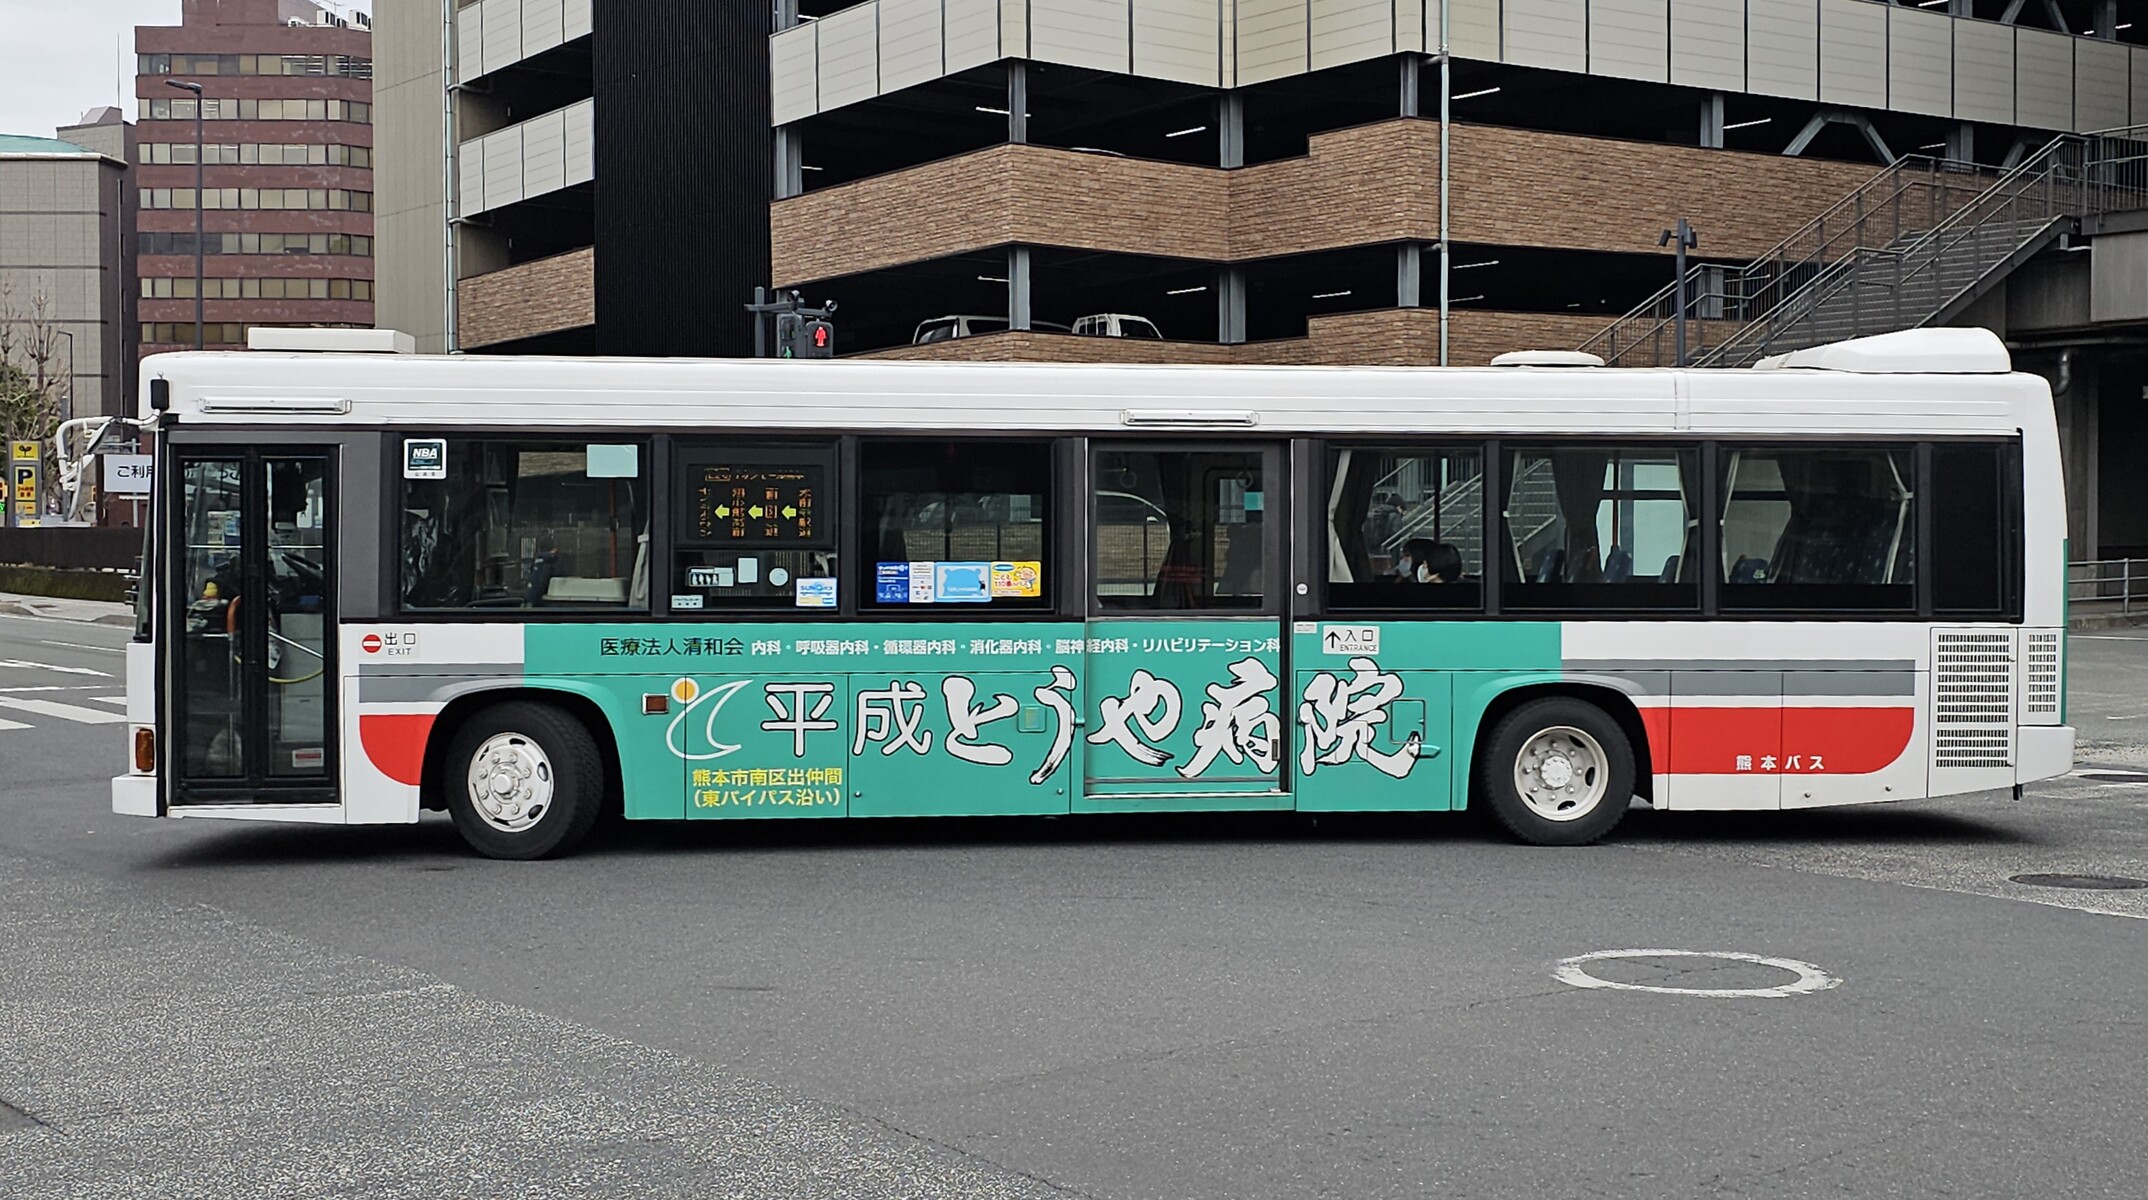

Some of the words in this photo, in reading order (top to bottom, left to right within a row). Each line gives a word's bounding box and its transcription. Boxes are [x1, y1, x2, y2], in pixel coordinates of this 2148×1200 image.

[412, 447, 438, 460] NBA
[18, 469, 33, 484] P
[385, 632, 416, 645] 出口
[1344, 629, 1374, 642] 入口
[600, 638, 744, 656] 医療法人清和会
[1340, 644, 1377, 652] ENTRANCE
[760, 656, 1421, 785] 平成とうや病院
[1736, 754, 1825, 771] 熊本バス
[692, 768, 843, 787] 熊本市南区出仲間
